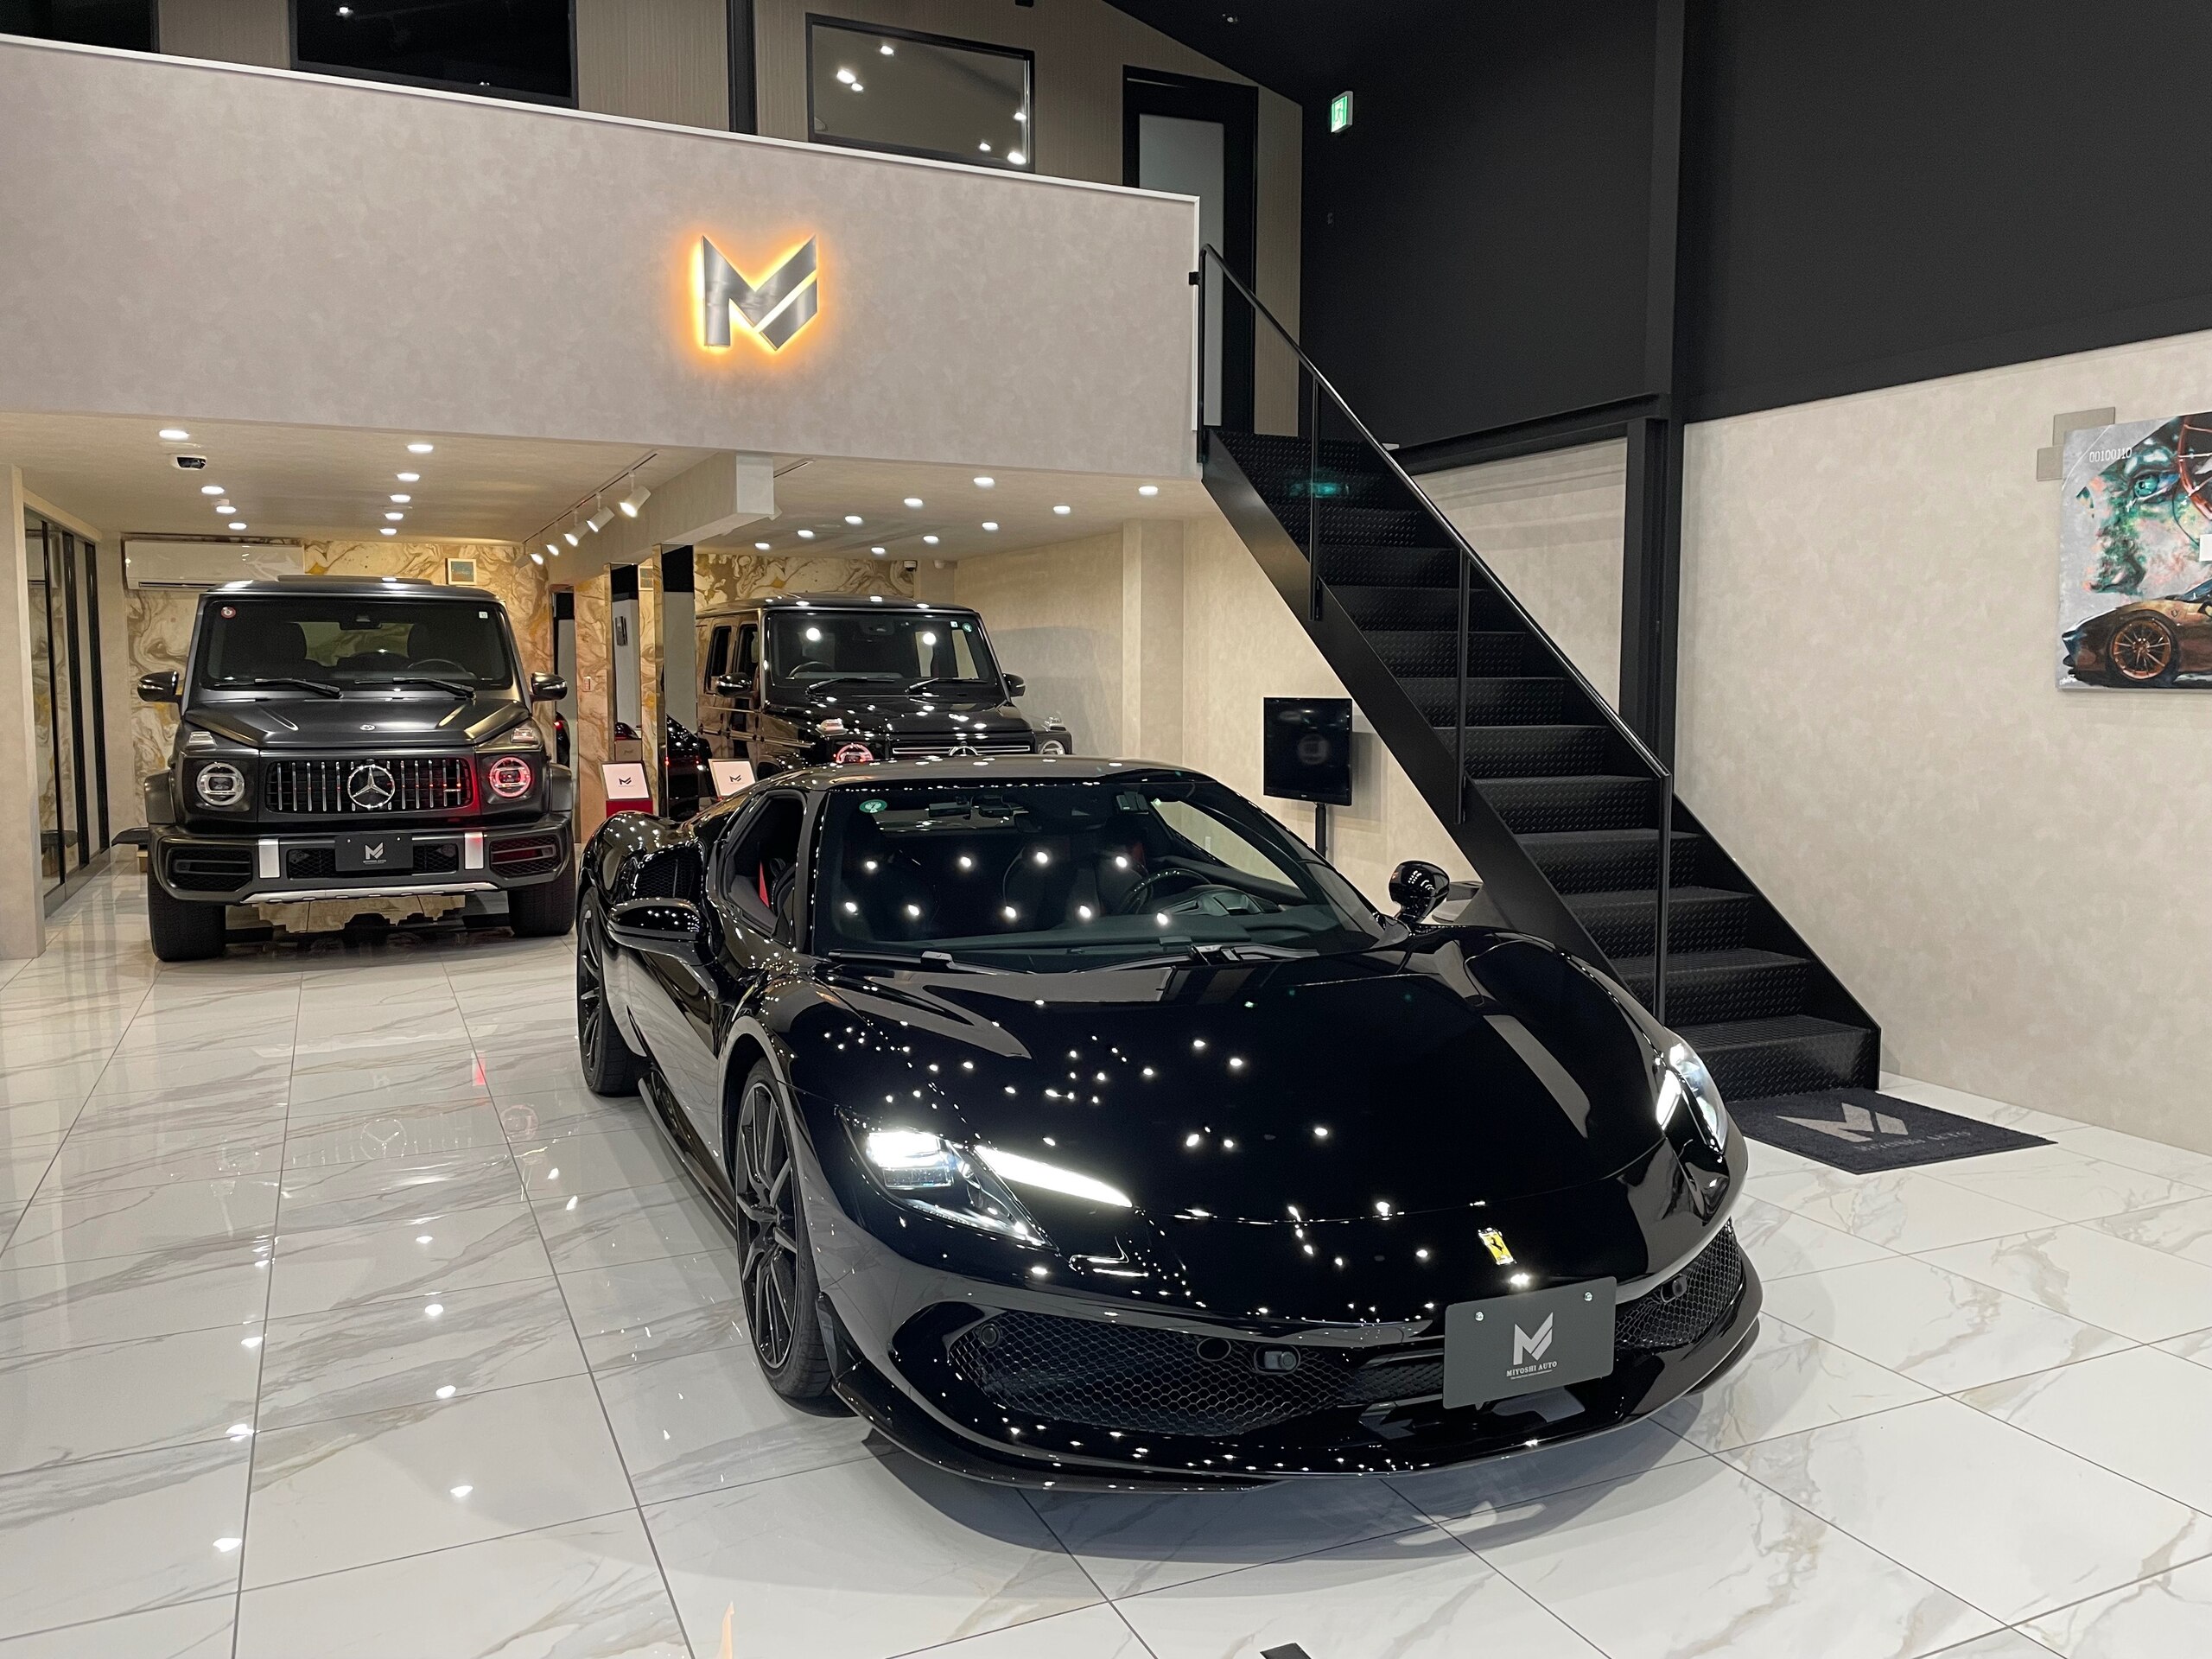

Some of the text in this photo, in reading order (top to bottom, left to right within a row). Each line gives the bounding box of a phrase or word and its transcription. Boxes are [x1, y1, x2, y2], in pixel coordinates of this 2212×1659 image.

[2089, 447, 2132, 462] 00100110
[1506, 1365, 1537, 1376] MIYOSHI
[1538, 1361, 1557, 1370] AUTO
